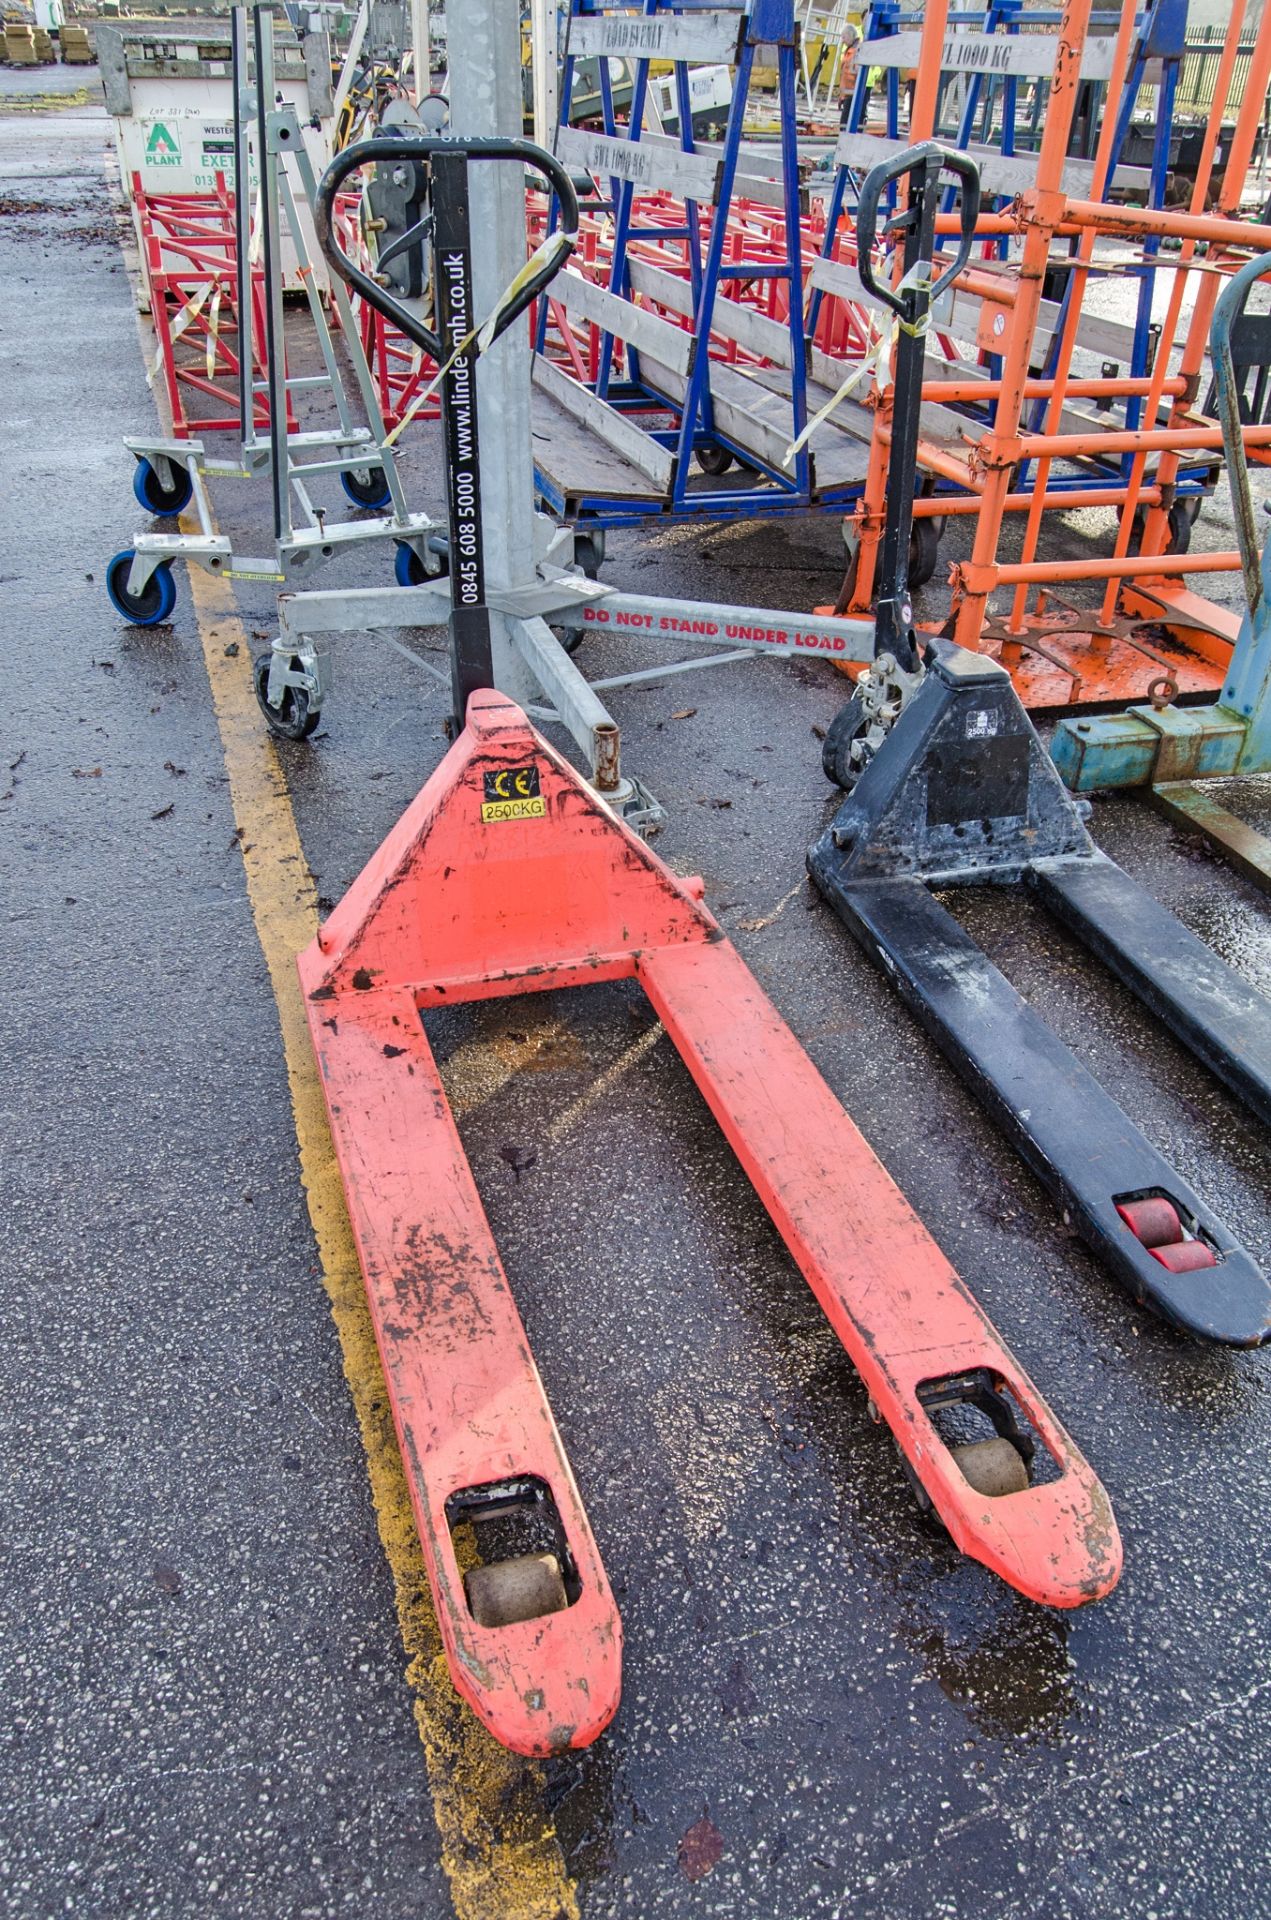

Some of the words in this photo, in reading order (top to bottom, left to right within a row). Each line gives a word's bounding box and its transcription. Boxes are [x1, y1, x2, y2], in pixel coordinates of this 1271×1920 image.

[606, 24, 628, 48] LOAD
[629, 24, 664, 49] EVENLY
[957, 44, 989, 66] 1000
[990, 44, 1013, 69] KG
[203, 126, 235, 134] WESTER
[145, 155, 183, 166] PLANT
[202, 155, 255, 168] EXETR
[611, 148, 631, 174] 1000
[632, 152, 646, 177] KG
[443, 252, 472, 461] www.lindemh.co.uk
[456, 472, 475, 518] 5000
[459, 522, 477, 556] 608
[461, 561, 479, 604] 0845
[583, 607, 610, 623] DO
[616, 611, 654, 628] NOT
[659, 617, 719, 636] STAND
[725, 623, 788, 645] UNDER
[795, 632, 846, 651] LOAD
[967, 727, 985, 737] 2500
[495, 769, 530, 798] CE
[486, 800, 542, 819] 2500KG
